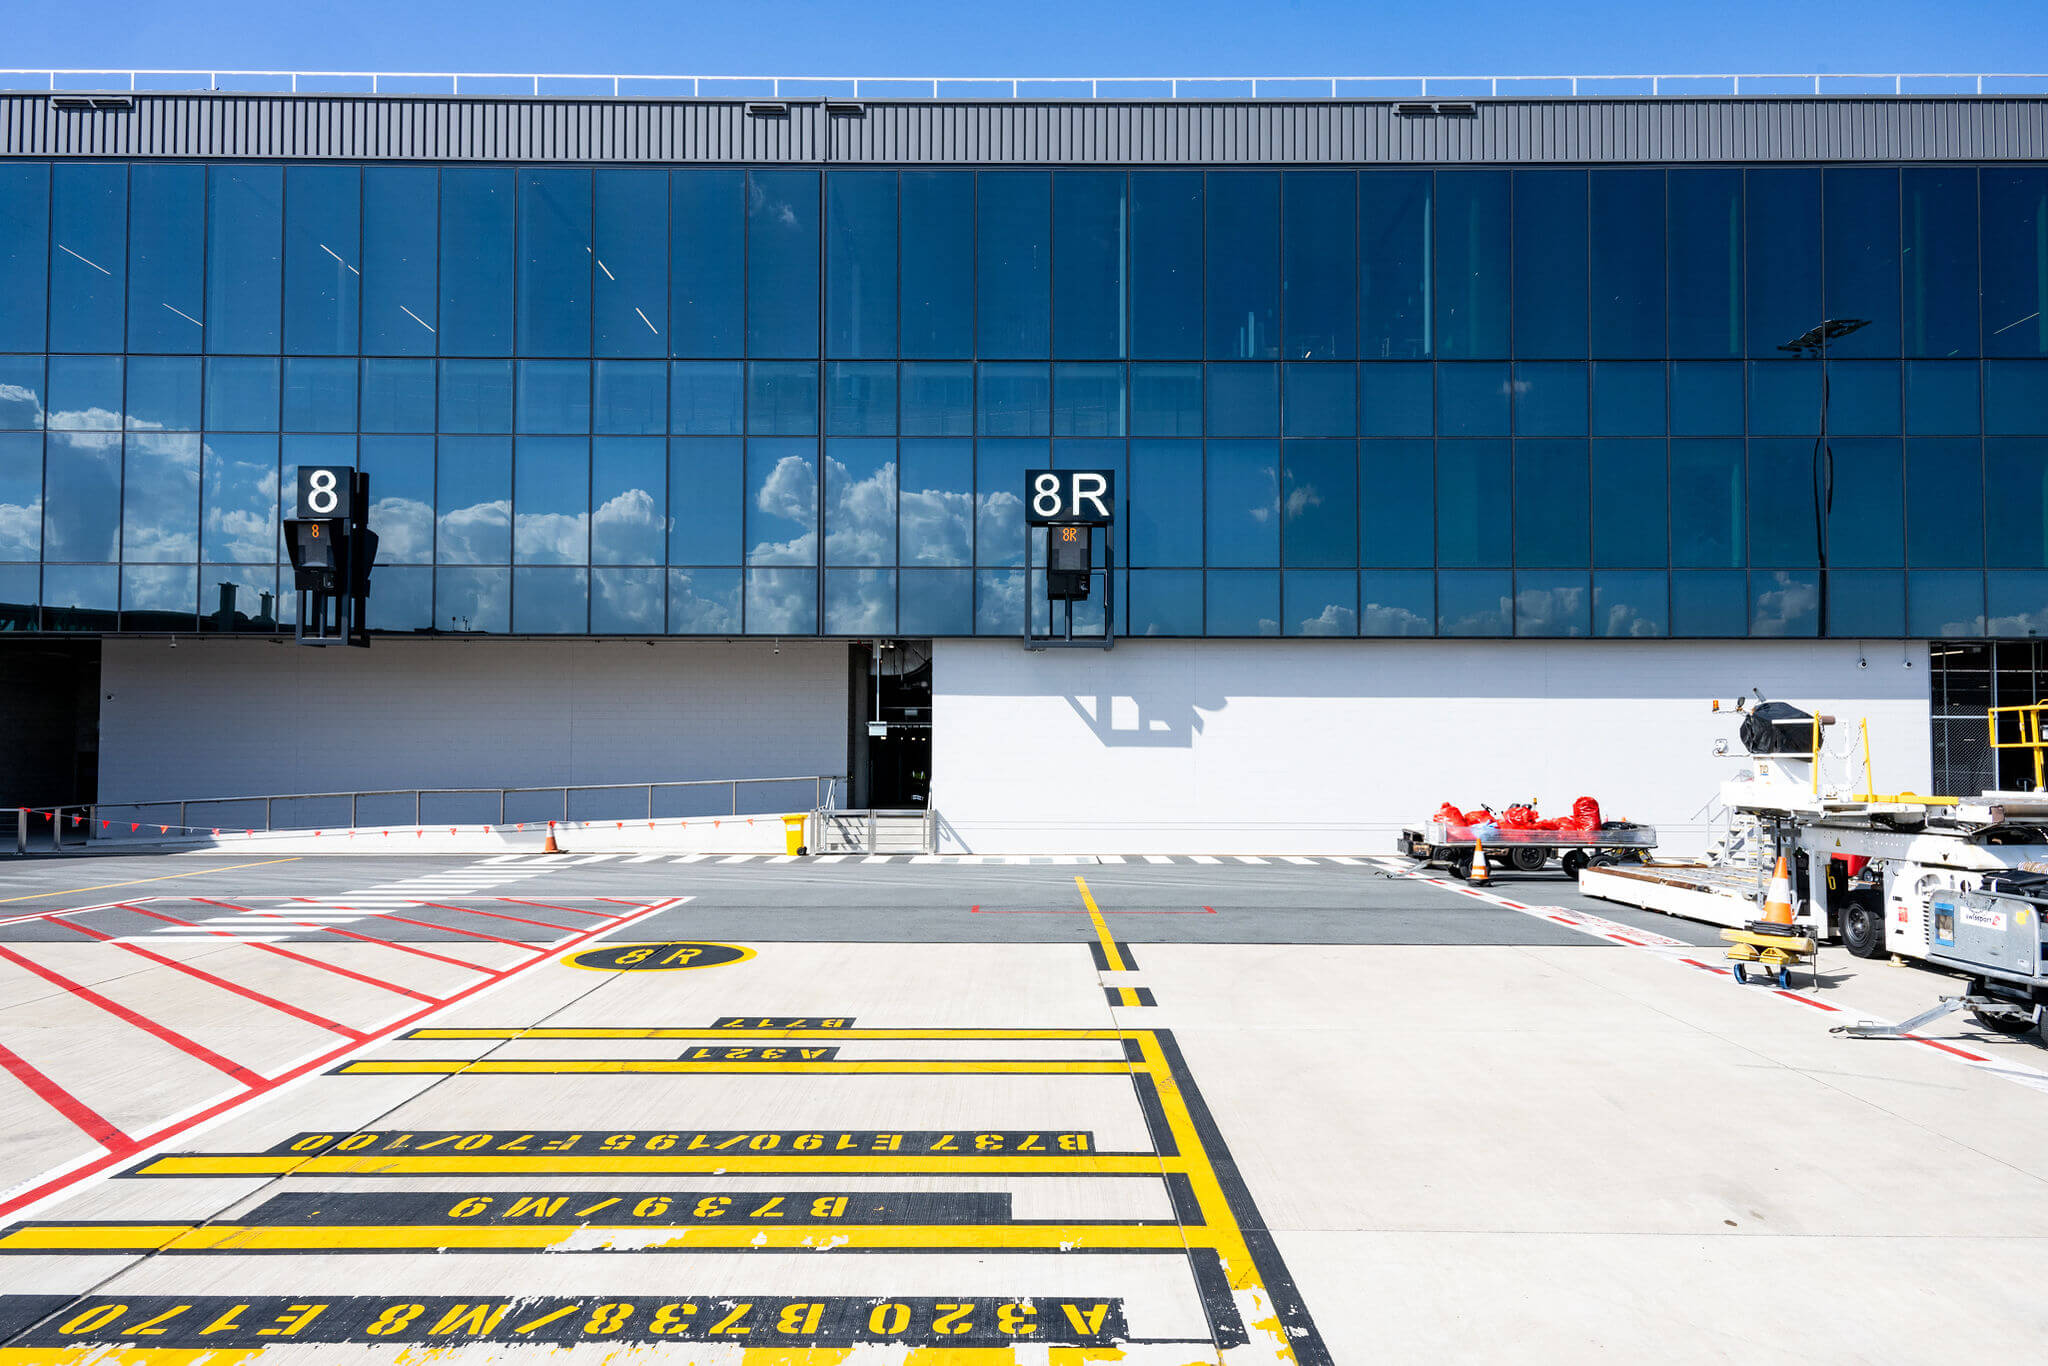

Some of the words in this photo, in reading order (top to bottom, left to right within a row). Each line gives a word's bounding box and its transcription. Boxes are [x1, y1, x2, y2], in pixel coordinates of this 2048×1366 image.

[308, 469, 338, 513] 8
[311, 524, 320, 538] 8
[1062, 527, 1077, 542] 8R
[722, 1018, 845, 1028] B717
[692, 1048, 828, 1059] A321
[290, 1134, 583, 1151] F70/100
[599, 1134, 902, 1151] E190/195
[929, 1134, 1089, 1151] B737
[447, 1196, 848, 1218] B739/M9
[58, 1304, 329, 1336] E170
[366, 1304, 825, 1335] B738/M8
[868, 1303, 1109, 1335] A320
